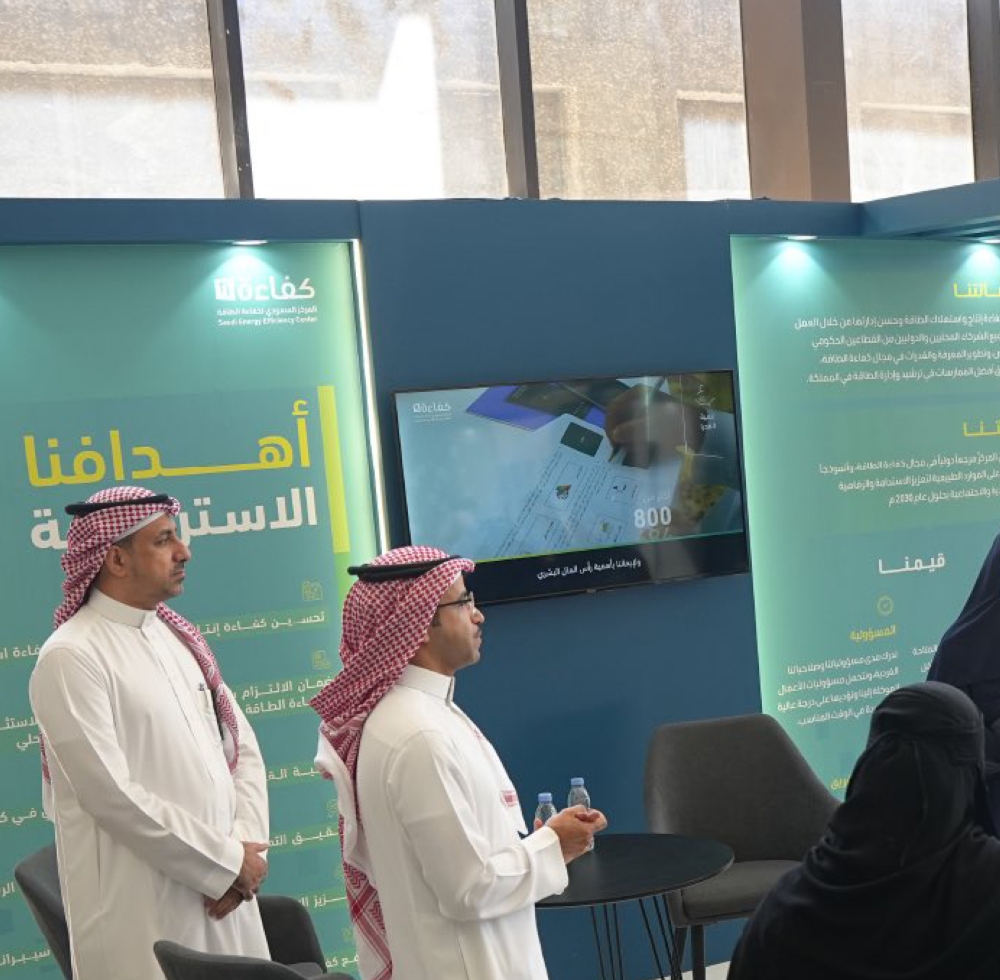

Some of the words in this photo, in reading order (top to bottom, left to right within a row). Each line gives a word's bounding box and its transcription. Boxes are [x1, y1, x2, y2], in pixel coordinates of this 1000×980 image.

[238, 273, 316, 301] كفاءة
[23, 399, 311, 487] أهدافنا
[31, 486, 318, 550] الاسترة
[634, 506, 672, 529] 800
[878, 553, 946, 575] قيمنا
[197, 622, 220, 637] إنتا
[223, 618, 267, 633] كفاءة
[271, 611, 325, 630] تحسين
[849, 624, 896, 644] المسؤولية
[12, 644, 40, 658] فاءة
[242, 680, 293, 700] الالتزام
[245, 699, 287, 715] الطاقة
[288, 696, 310, 709] اءة
[12, 807, 38, 826] في
[291, 826, 339, 845] قيق
